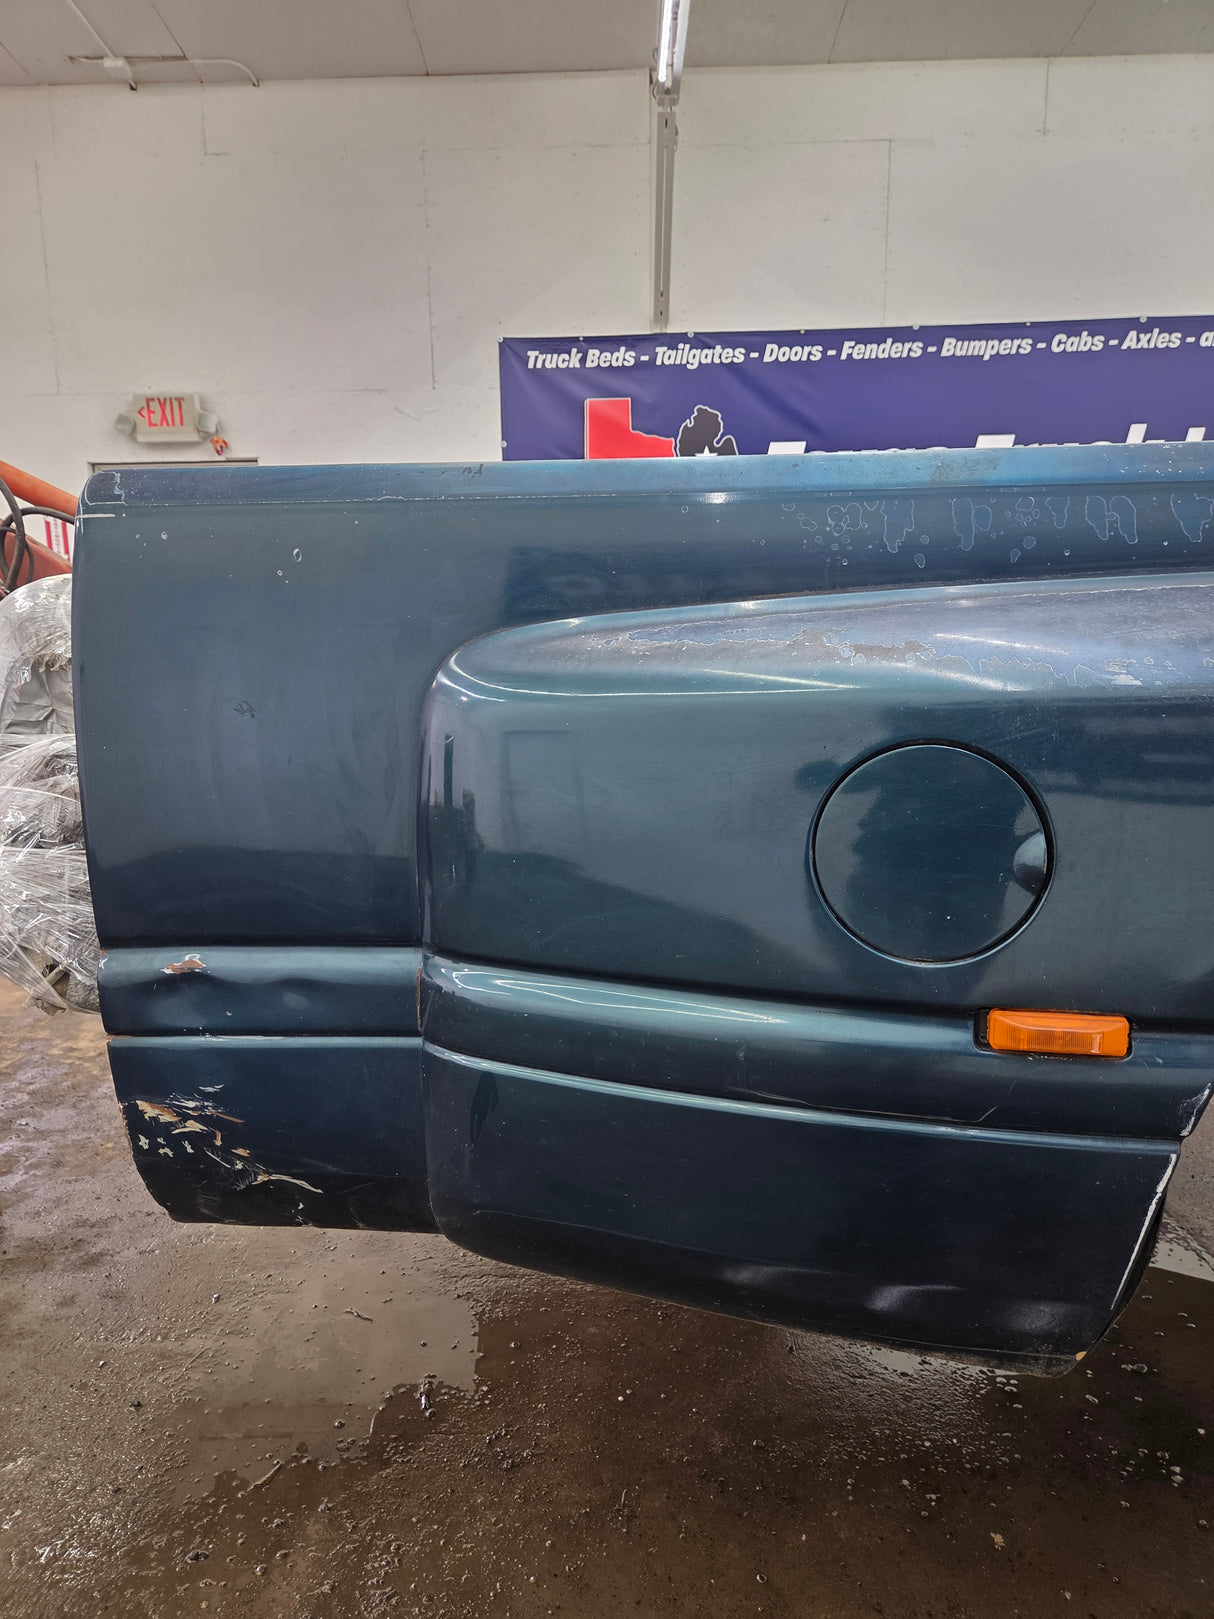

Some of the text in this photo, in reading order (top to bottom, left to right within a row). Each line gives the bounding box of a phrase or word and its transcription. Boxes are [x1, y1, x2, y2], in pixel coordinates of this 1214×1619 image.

[526, 348, 581, 369] Truck
[585, 346, 636, 368] Beds
[655, 343, 745, 370] Tailgates
[763, 341, 823, 363] Doors
[840, 338, 923, 360] Fenders
[940, 337, 1033, 360] Bumpers
[1051, 331, 1105, 352] Cabs
[1120, 328, 1182, 350] Axles
[145, 397, 184, 427] EXIT
